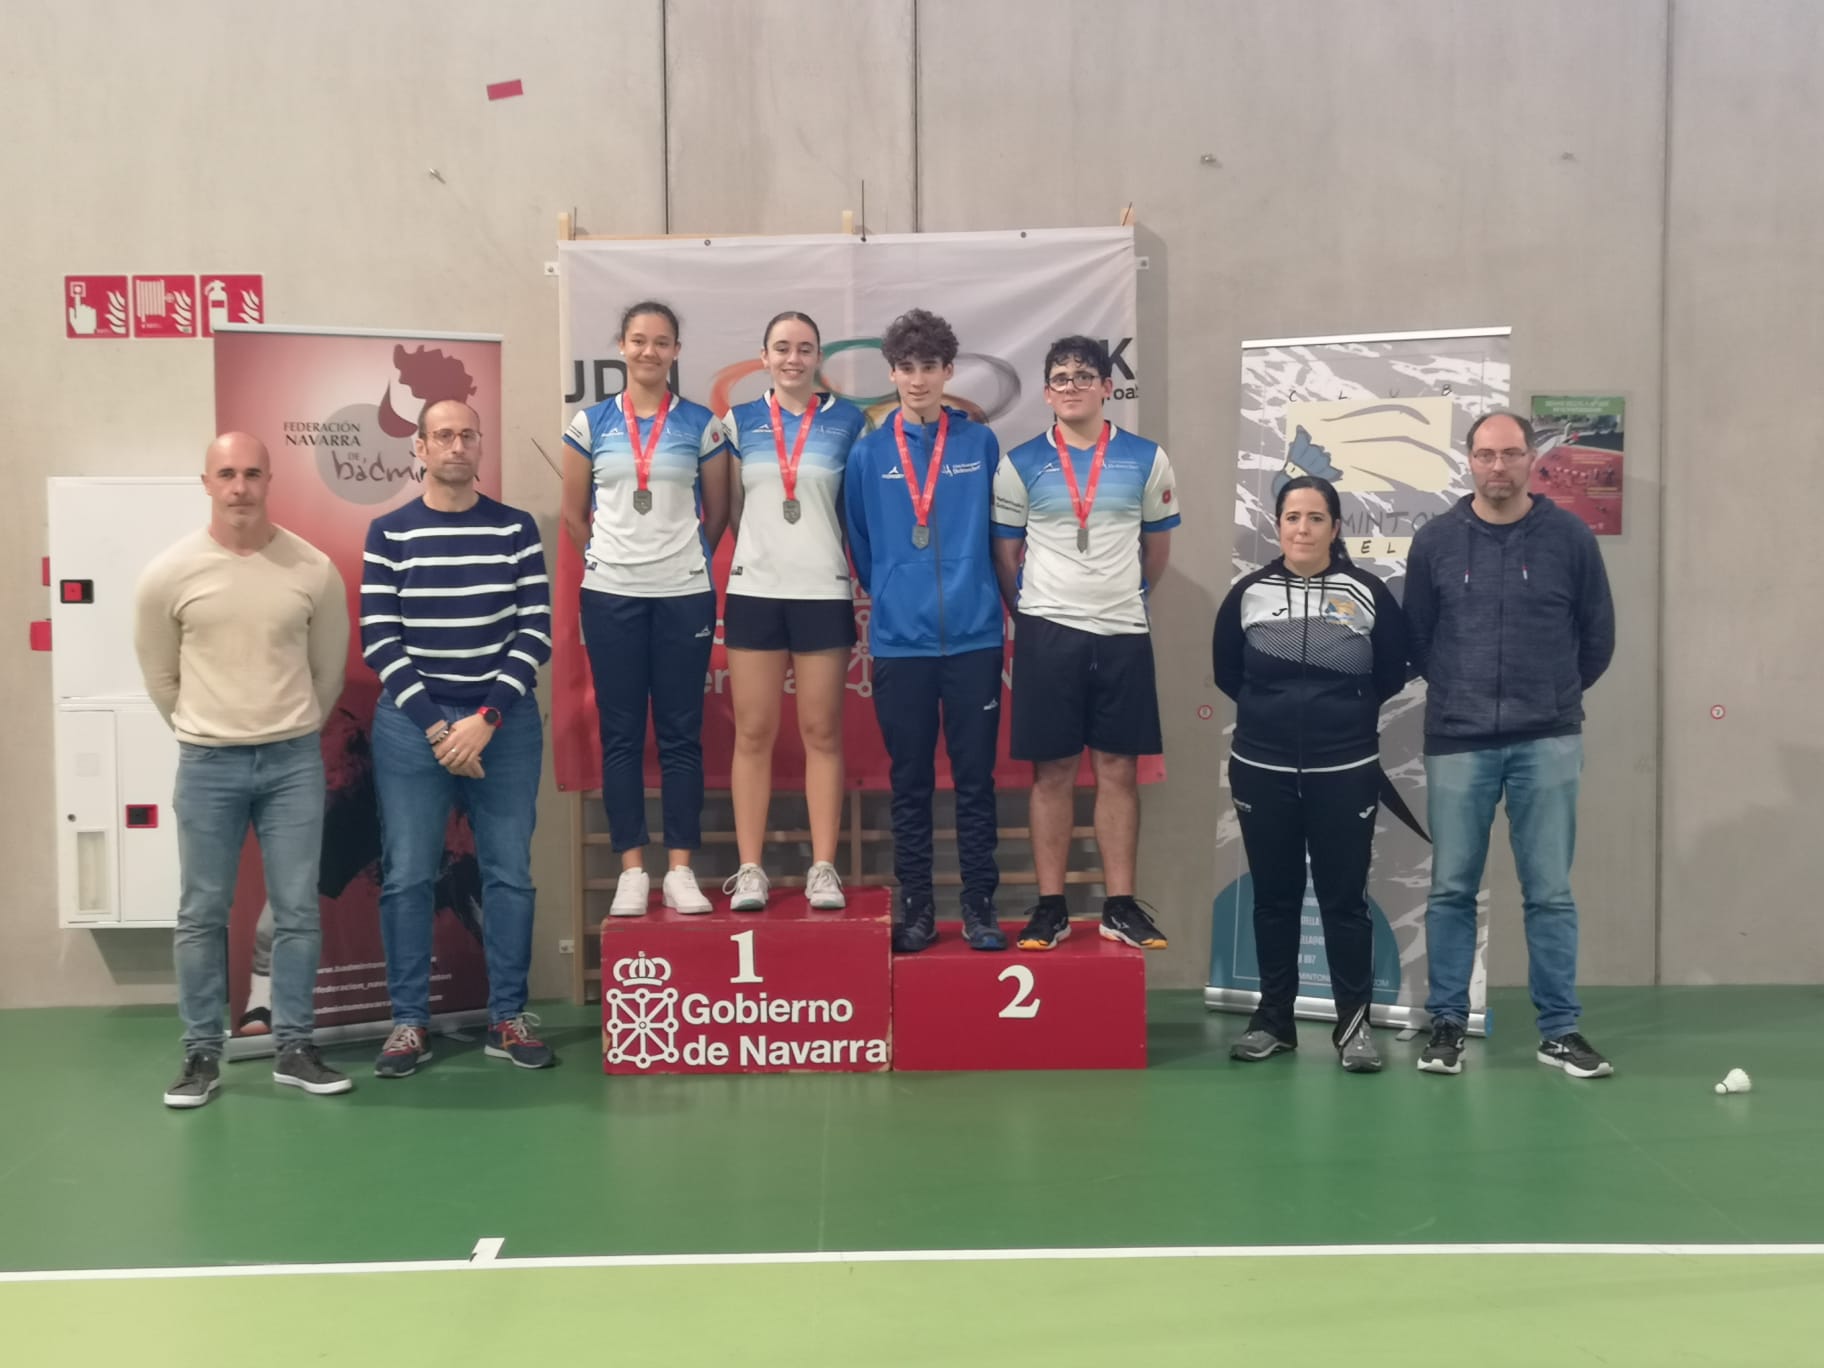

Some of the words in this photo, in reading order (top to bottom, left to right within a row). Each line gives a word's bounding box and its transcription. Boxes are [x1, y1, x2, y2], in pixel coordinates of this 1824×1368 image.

[285, 434, 361, 447] NAVARRA
[730, 929, 763, 983] 1
[997, 964, 1041, 1018] 2
[681, 992, 853, 1025] Gobierno
[682, 1034, 729, 1066] de
[738, 1034, 888, 1066] Navarra
